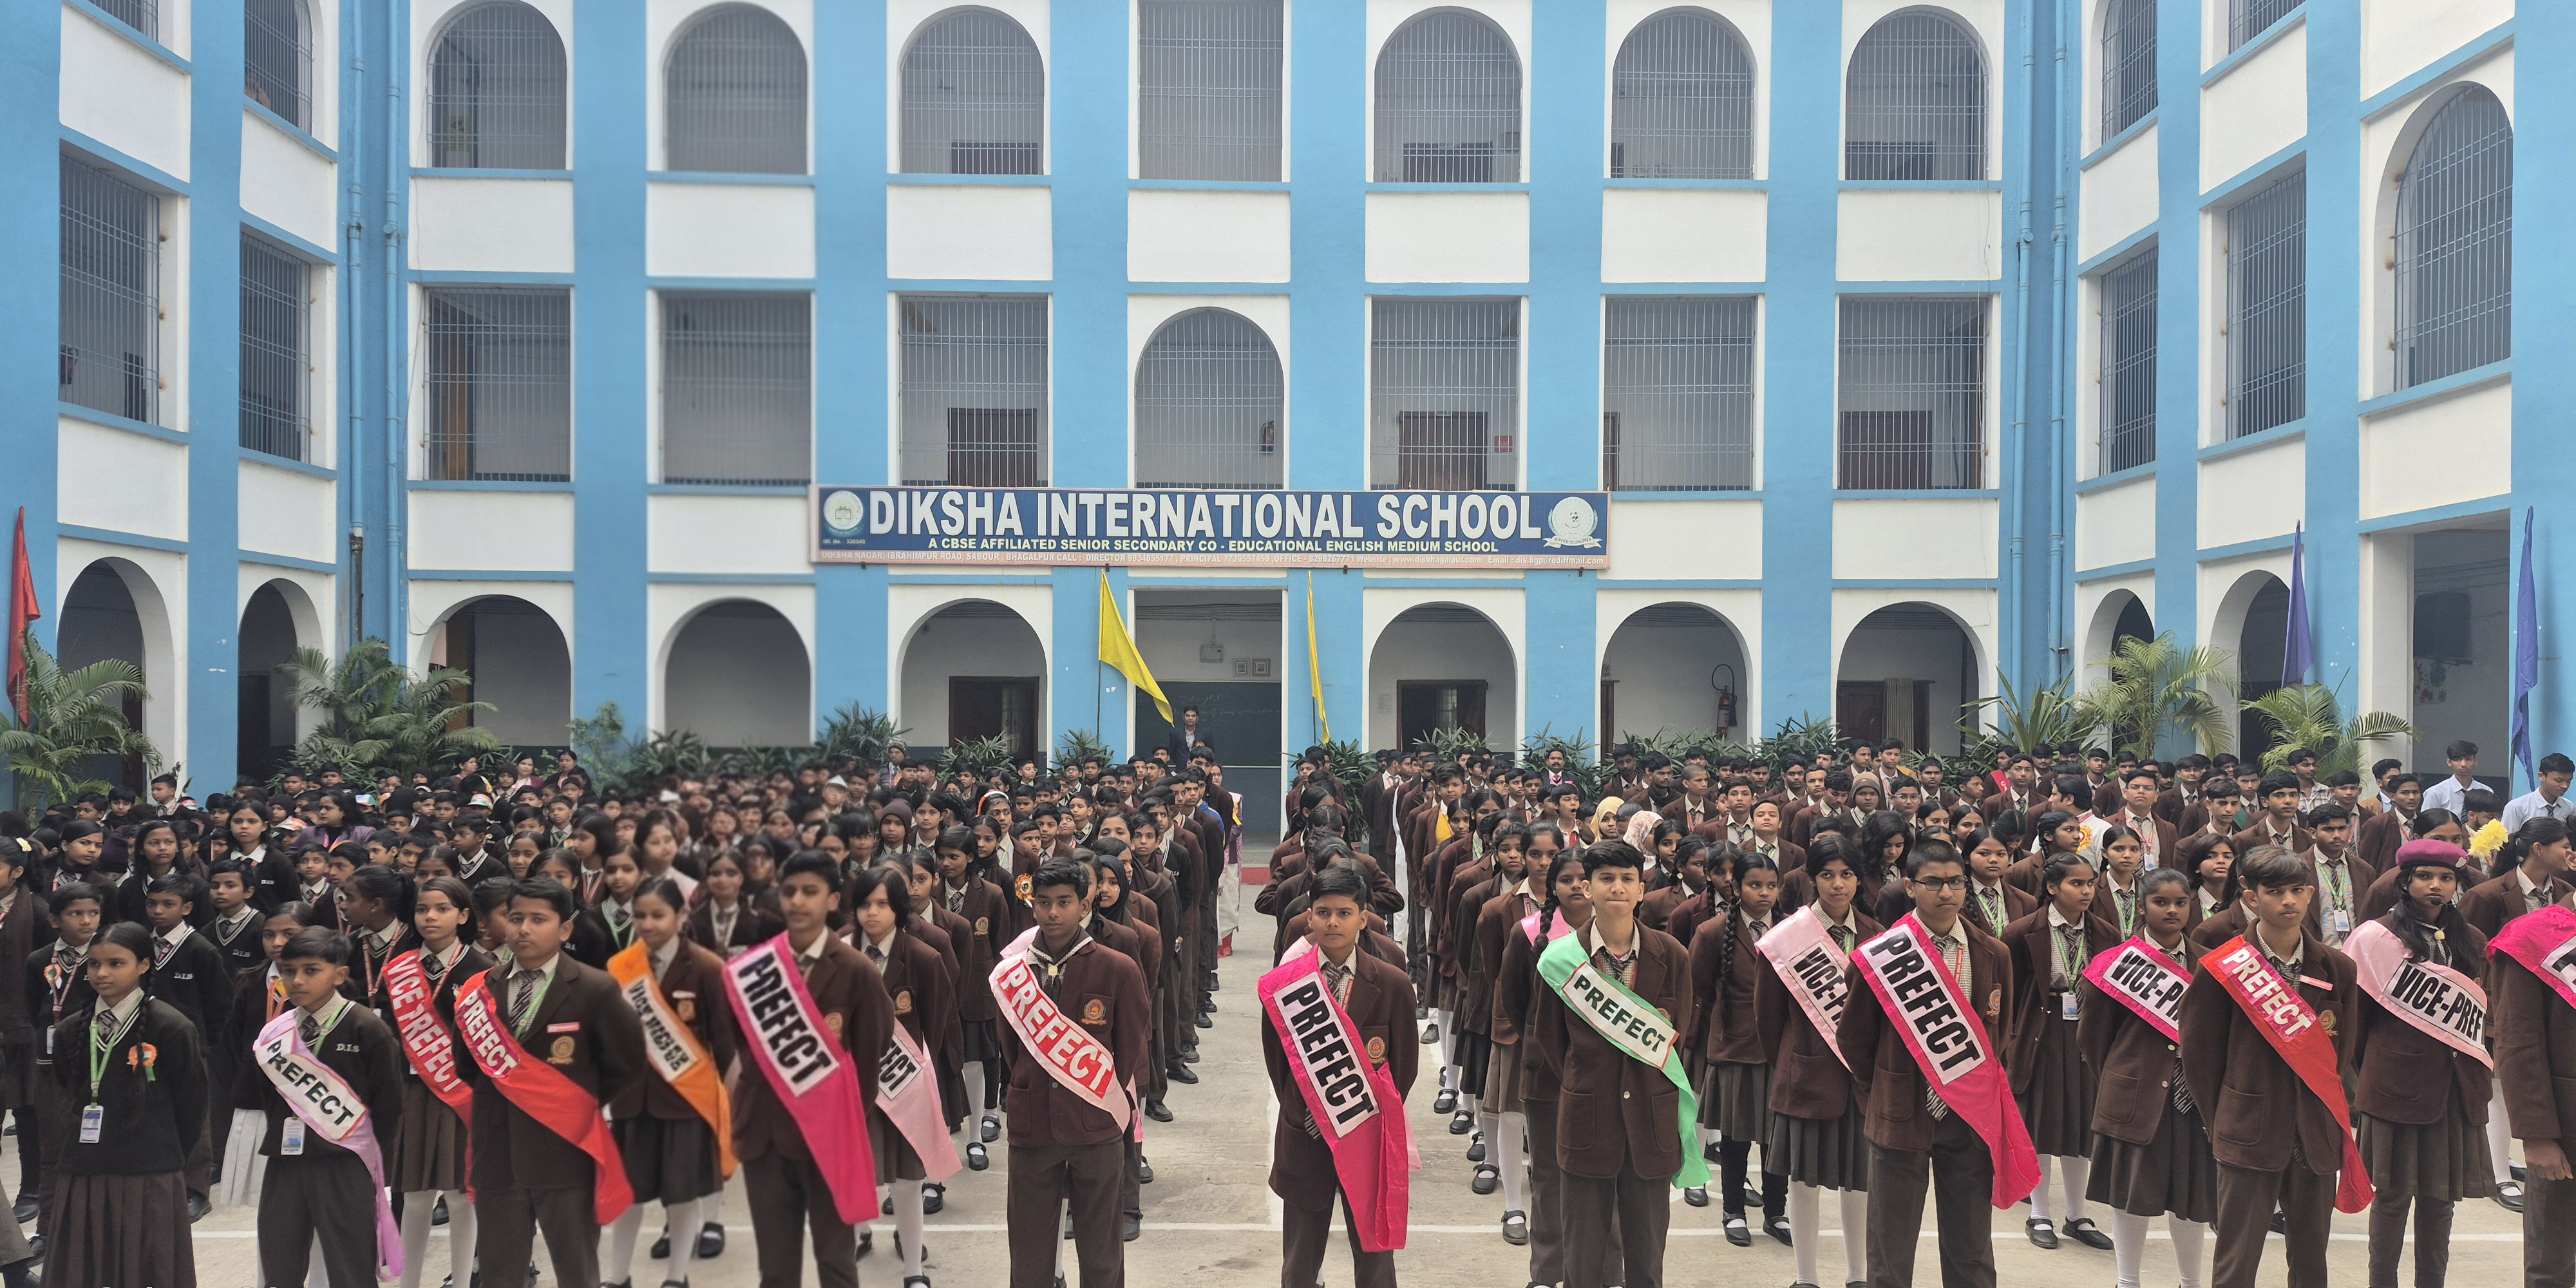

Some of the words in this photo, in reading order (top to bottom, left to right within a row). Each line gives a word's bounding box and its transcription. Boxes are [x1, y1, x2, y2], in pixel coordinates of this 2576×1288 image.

[869, 490, 1024, 536] DIKSHA
[1037, 493, 1364, 539] INTERNATIONAL
[1376, 494, 1542, 540] SCHOOL
[928, 538, 938, 548] A
[942, 538, 976, 549] CBSE
[980, 538, 1057, 549] AFFILIATED
[1061, 539, 1110, 550] SENIOR
[1114, 540, 1194, 551] SECONDARY
[1198, 540, 1217, 551] CO
[1229, 540, 1322, 551] EDUCATIONAL
[1326, 540, 1383, 551] ENGLISH
[1387, 541, 1440, 552] MEDIUM
[1444, 541, 1499, 552] SCHOOL
[855, 552, 885, 561] NAGAR,
[940, 553, 964, 562] ROAD,
[1394, 556, 1481, 564] www.disbhagalpur.com
[1516, 556, 1604, 565] dis.bgp@rediffmail.com
[388, 955, 424, 1010] VICE
[737, 951, 832, 1084] PREFECT
[1573, 974, 1667, 1053] PREFECT
[1869, 931, 1981, 1072] PREFECT
[2222, 947, 2312, 1036] PREFECT
[459, 989, 518, 1075] PREFECT
[999, 964, 1113, 1091] PREFECT
[1281, 980, 1375, 1126] PREFECT
[267, 1039, 354, 1126] PREFECT
